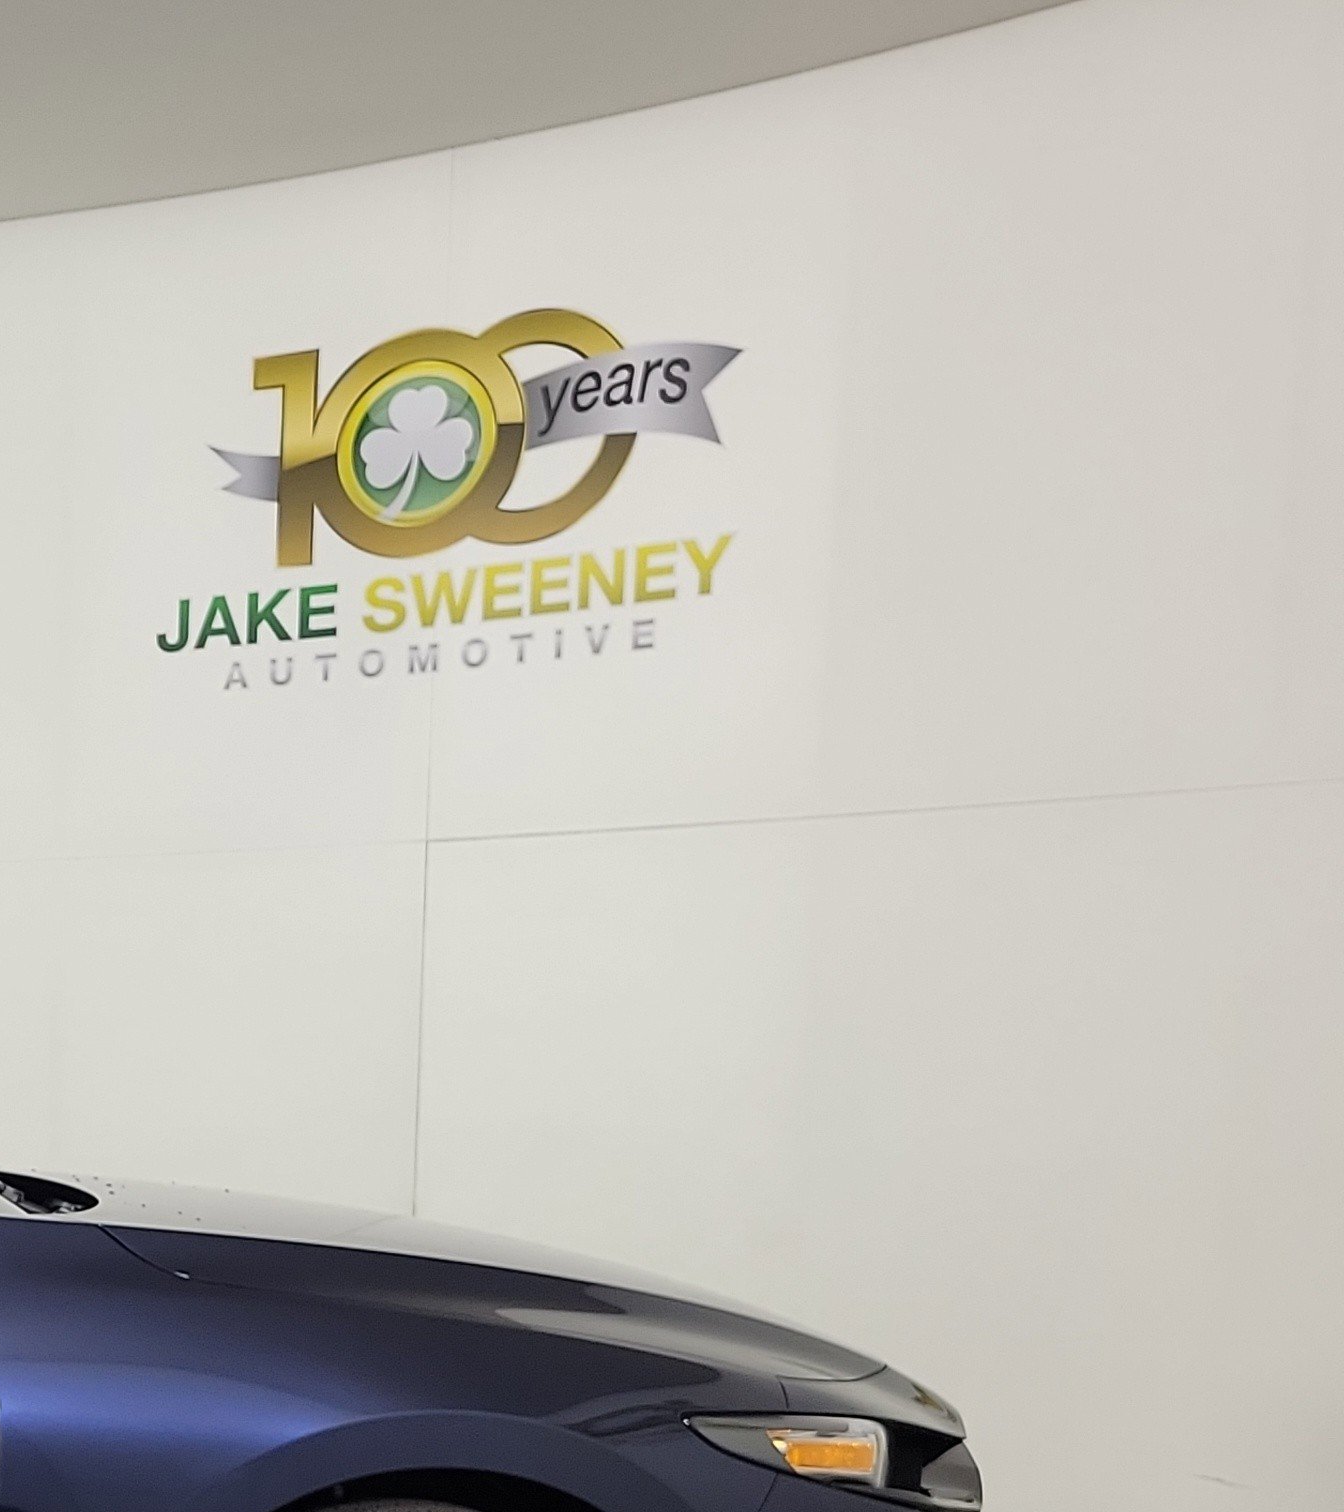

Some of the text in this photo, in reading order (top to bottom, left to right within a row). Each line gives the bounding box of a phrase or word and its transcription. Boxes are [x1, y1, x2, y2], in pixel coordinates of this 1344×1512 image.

[253, 308, 690, 567] 100 years
[156, 531, 735, 652] JAKE SWEENEY
[223, 619, 658, 690] AUTOMOTIVE
